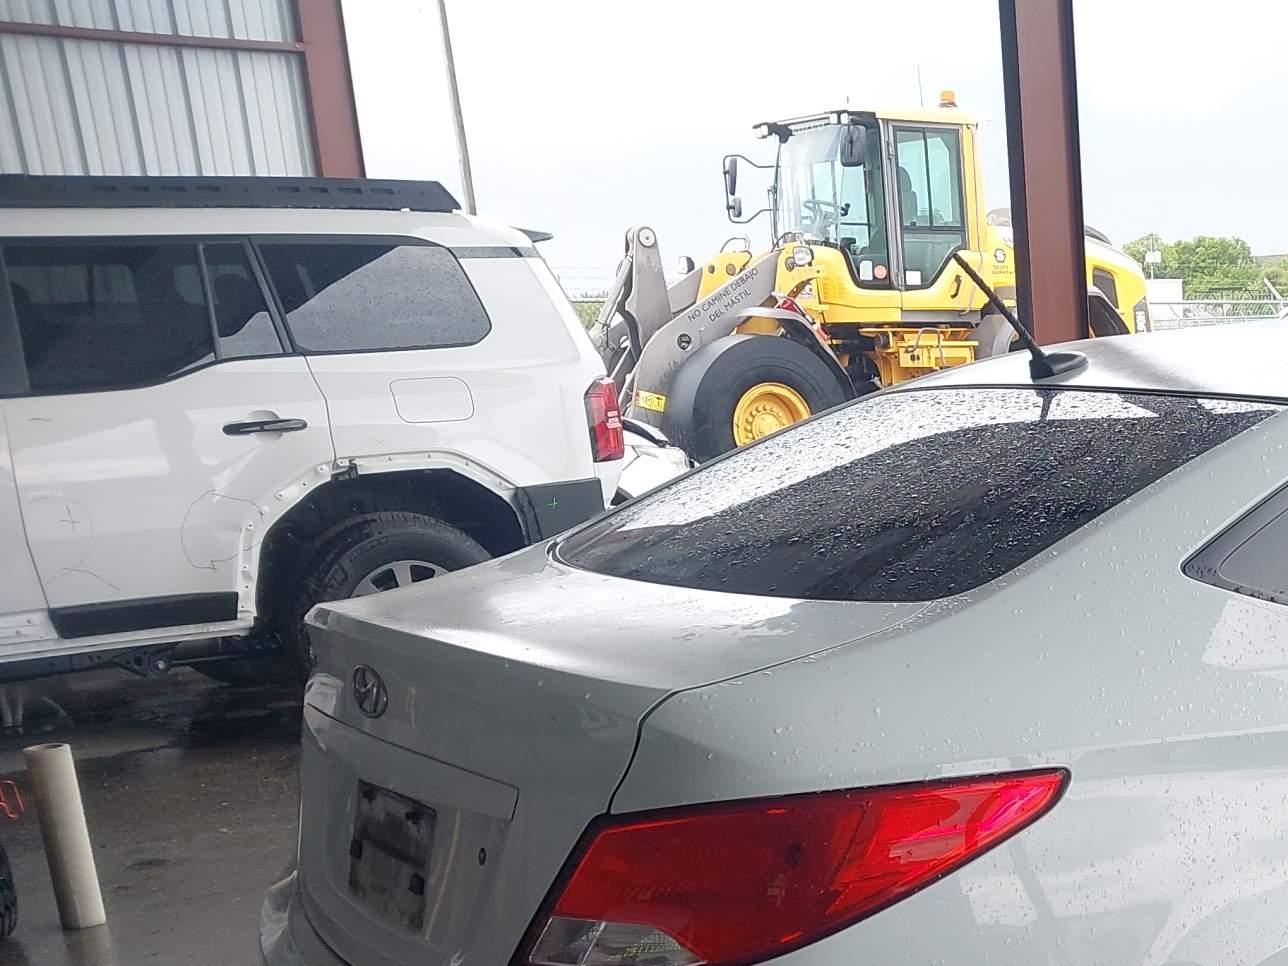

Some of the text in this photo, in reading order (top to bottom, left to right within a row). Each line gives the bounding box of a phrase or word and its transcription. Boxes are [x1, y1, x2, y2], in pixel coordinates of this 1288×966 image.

[687, 267, 759, 323] NO CAMINE DEBAJO
[708, 308, 726, 322] DEL
